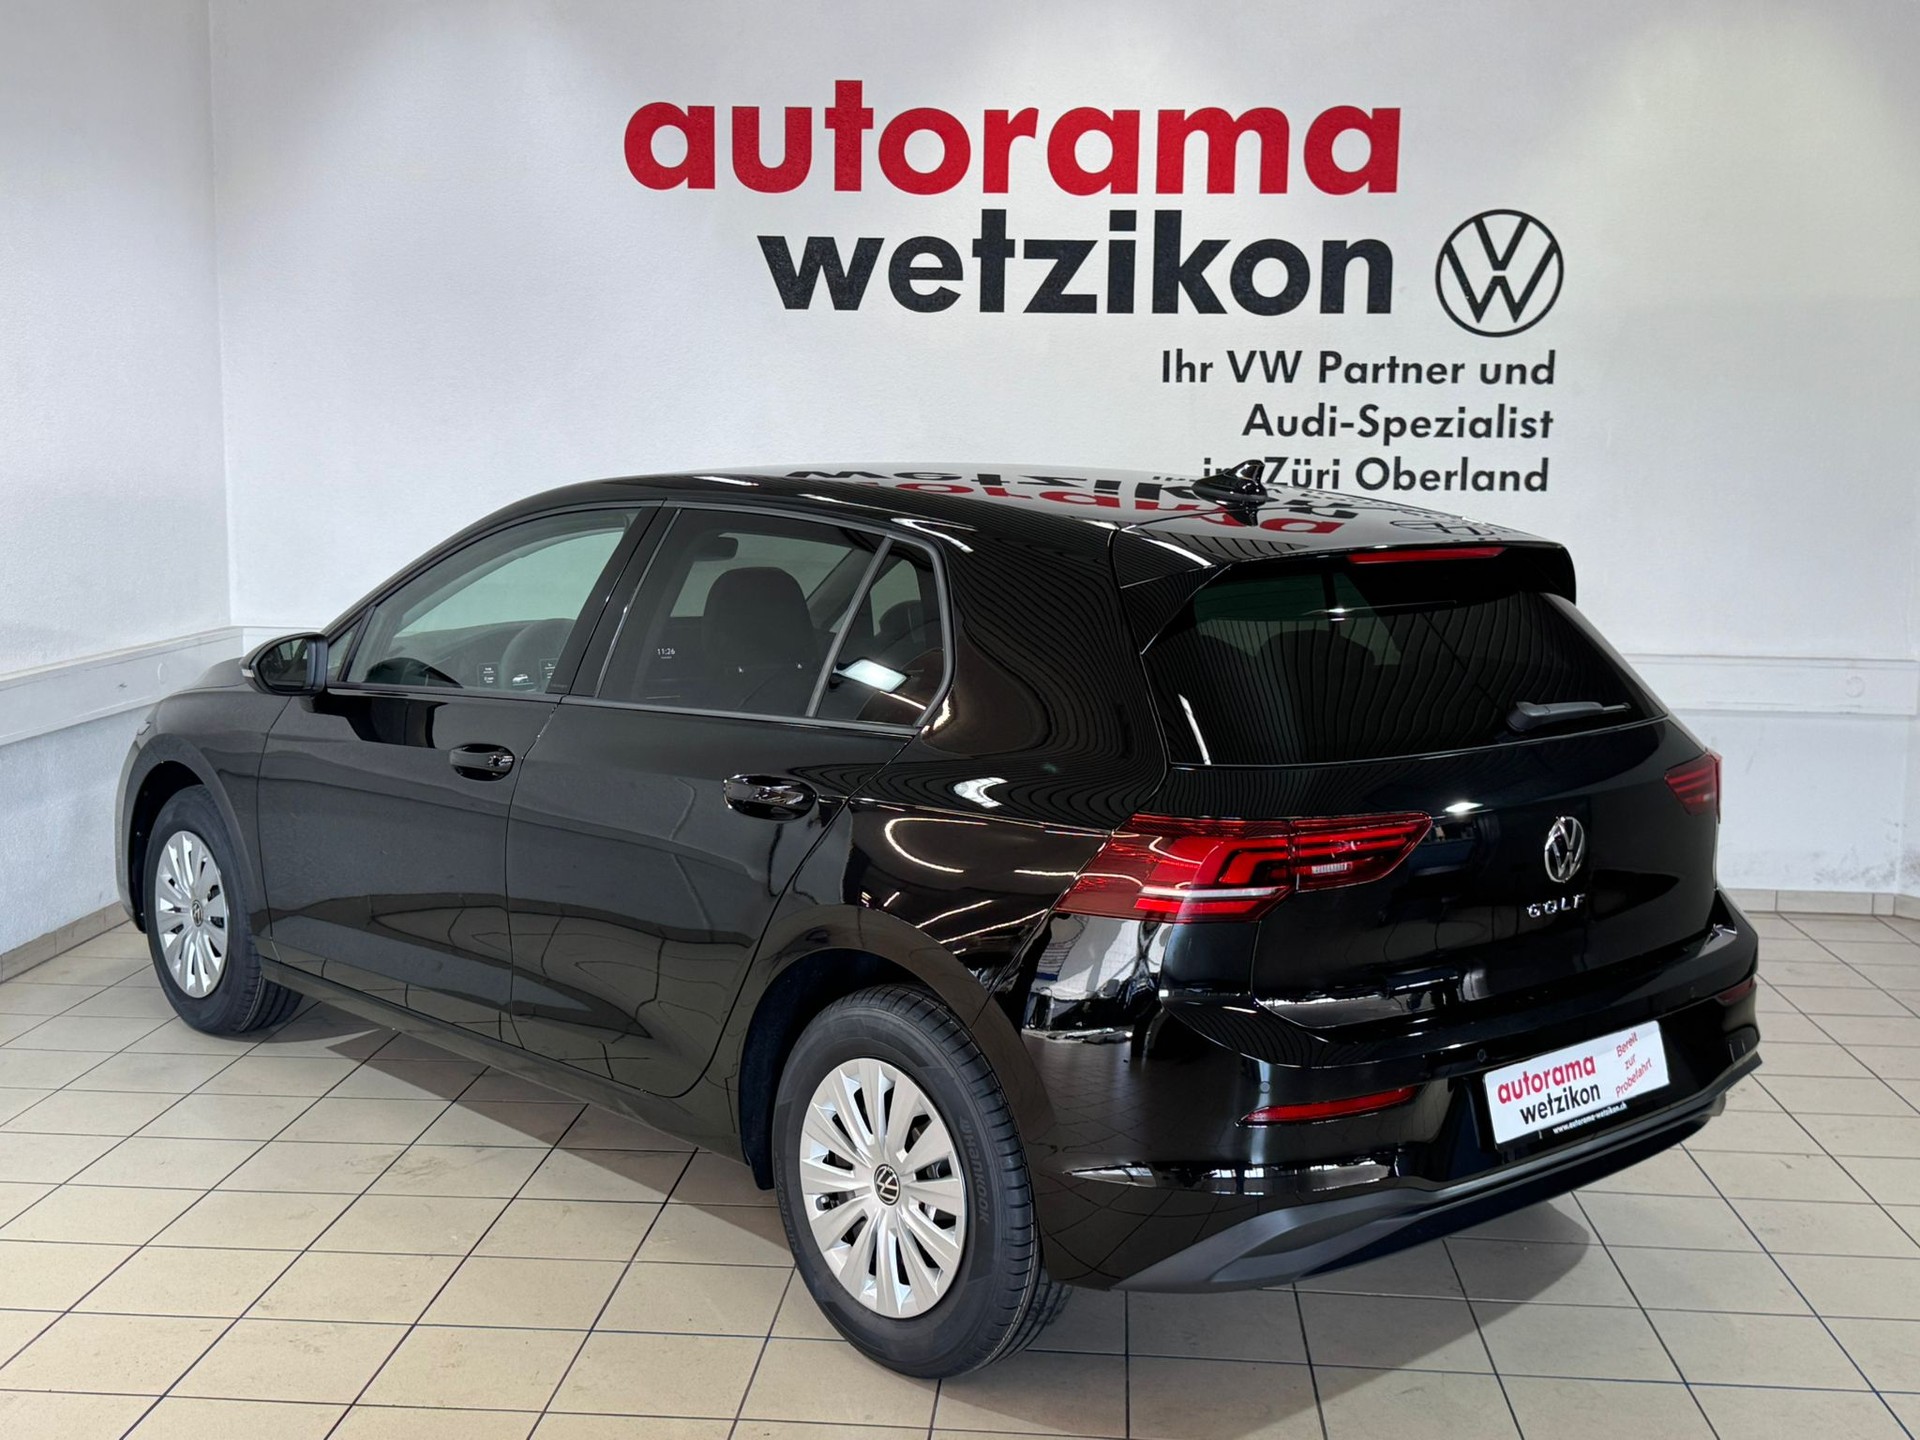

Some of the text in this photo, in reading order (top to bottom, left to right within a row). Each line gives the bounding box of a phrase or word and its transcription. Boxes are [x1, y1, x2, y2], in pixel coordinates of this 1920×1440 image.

[625, 80, 1401, 196] autorama
[757, 209, 1393, 316] wetzikon
[1163, 349, 1555, 385] Ihr VW Partner und
[1242, 403, 1553, 446] Audi-Spezialist
[1264, 456, 1340, 489] Züri
[1356, 457, 1549, 491] Oberland
[1526, 893, 1586, 918] GOLF
[1616, 1032, 1638, 1058] Bereit
[1624, 1053, 1637, 1070] zur
[1498, 1056, 1596, 1104] autorama
[1615, 1057, 1653, 1099] Probefahrt
[1519, 1083, 1601, 1125] wetzikon
